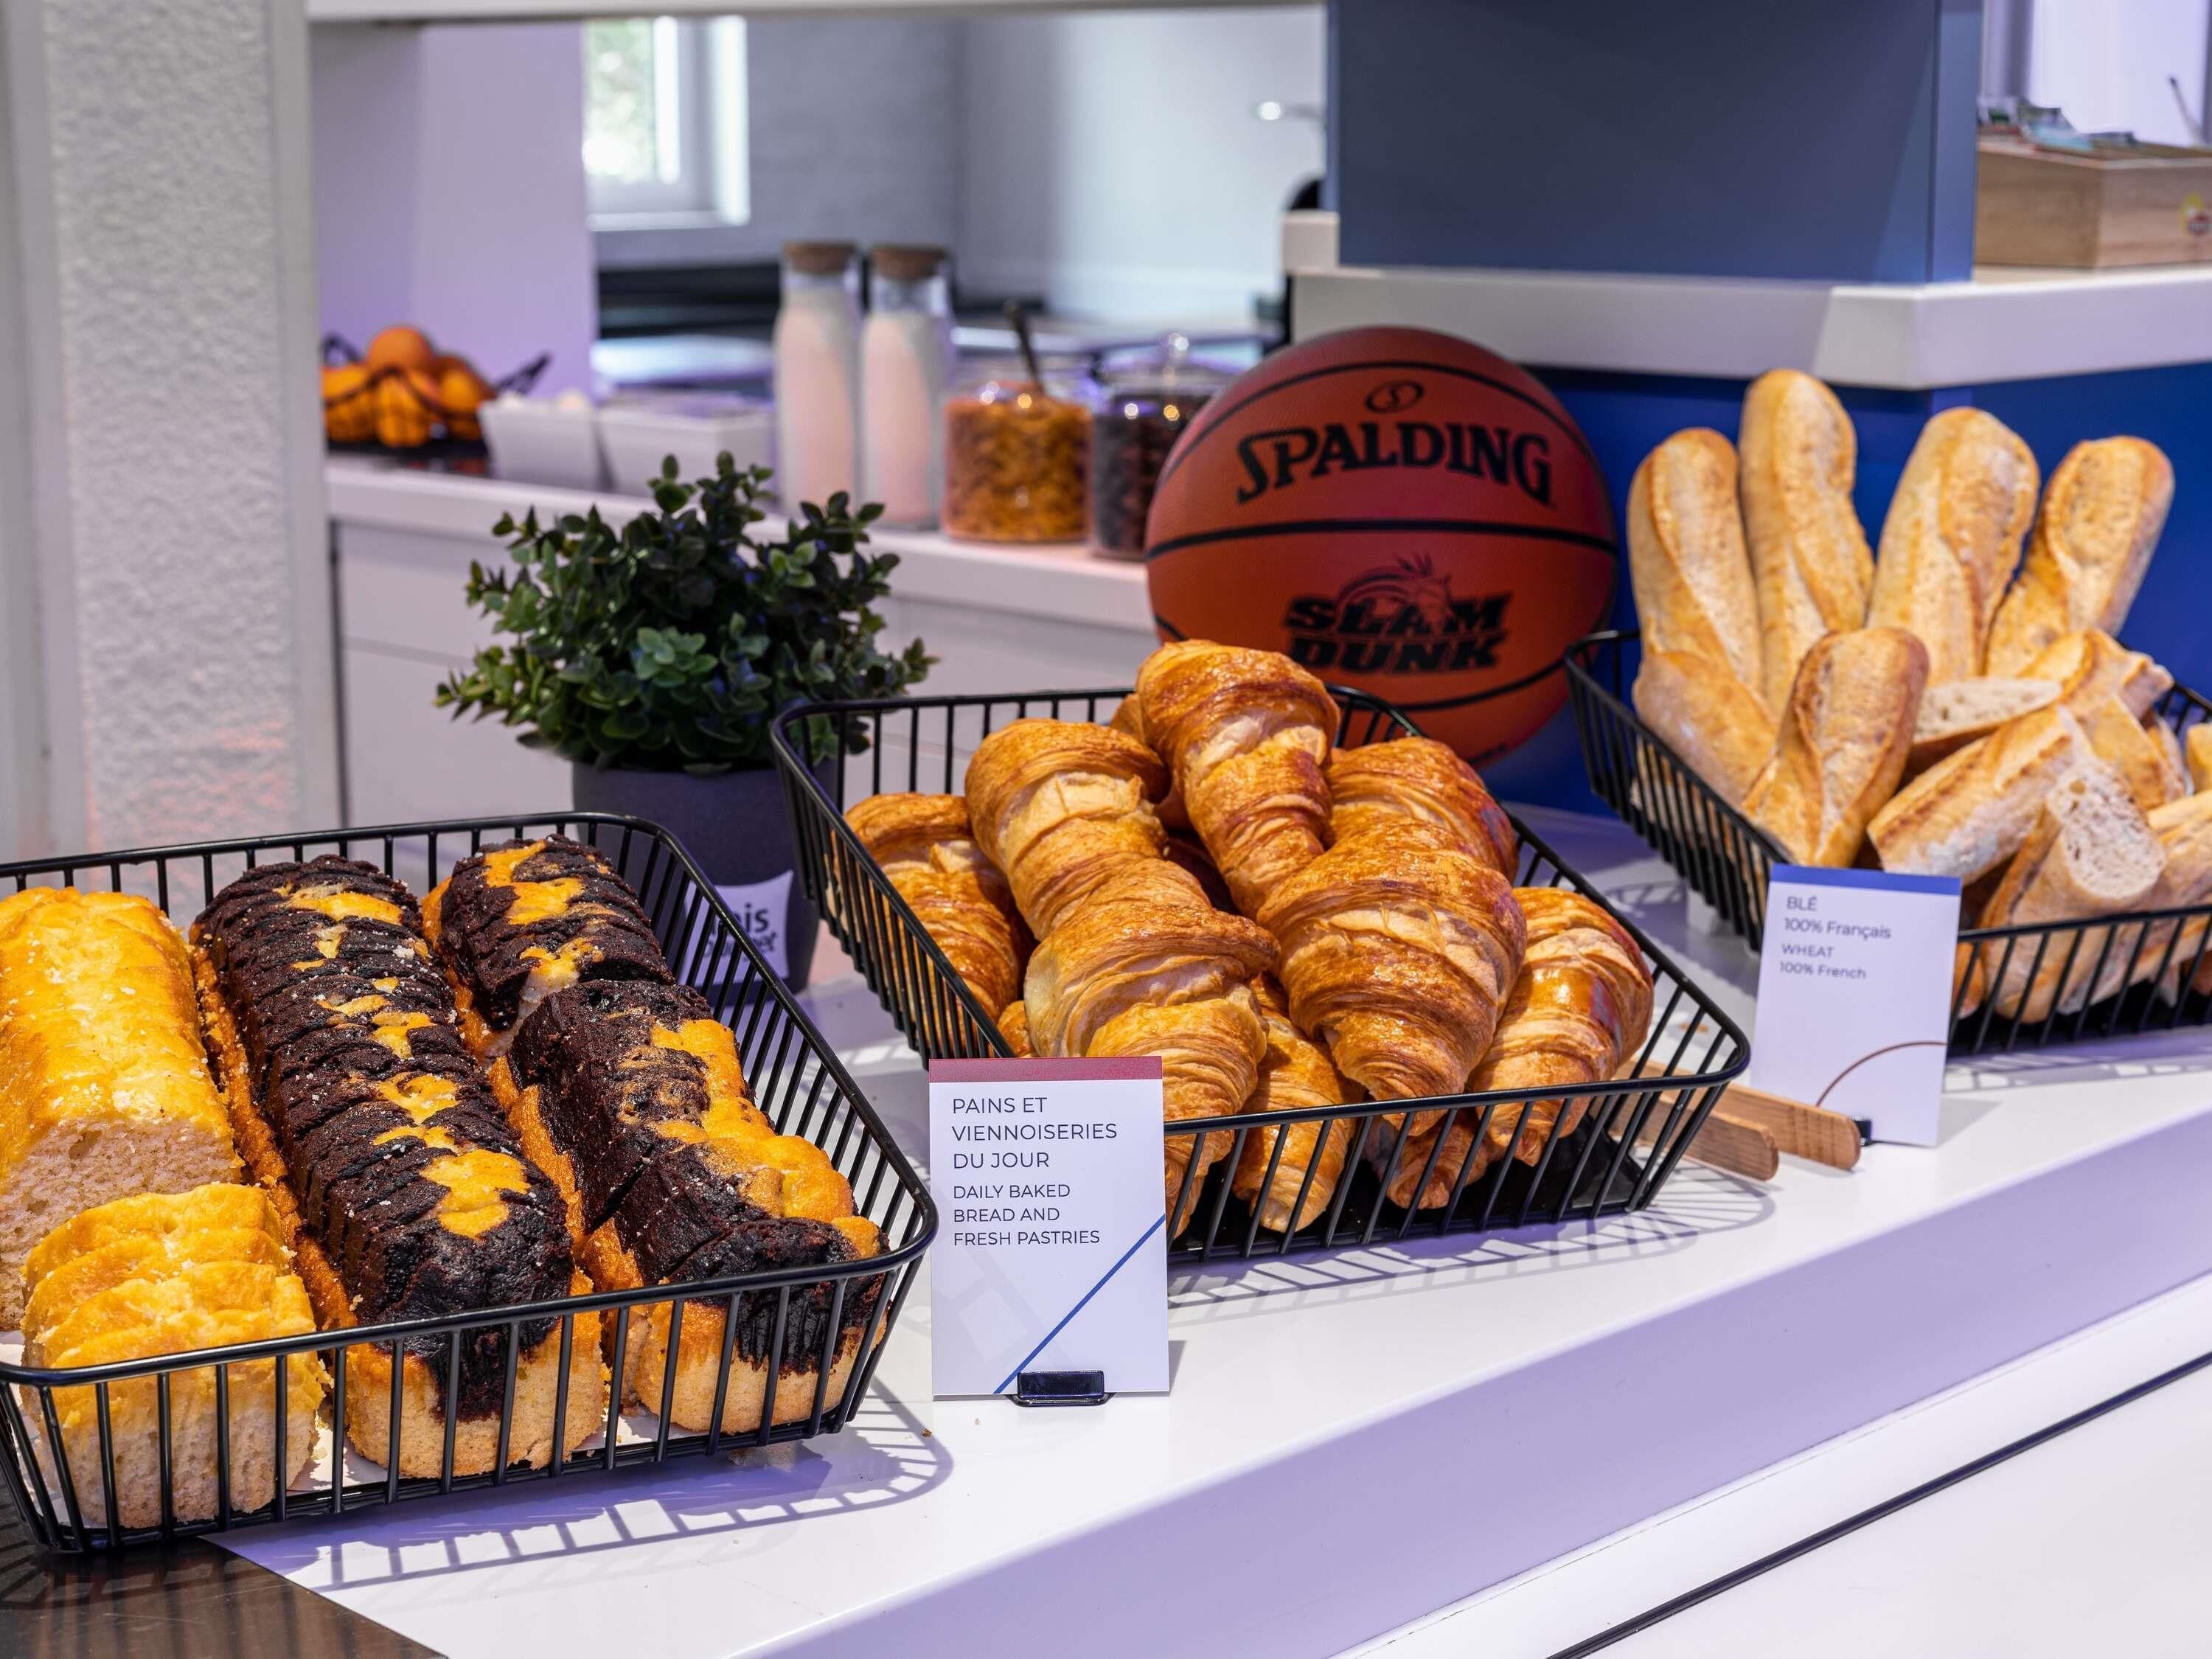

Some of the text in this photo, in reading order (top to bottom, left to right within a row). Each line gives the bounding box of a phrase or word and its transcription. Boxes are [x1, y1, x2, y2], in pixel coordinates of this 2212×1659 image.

[1237, 422, 1552, 506] SPALDING
[1286, 591, 1512, 632] SLAM
[1291, 633, 1505, 672] DUNK
[1787, 896, 1818, 911] BLÉ
[1784, 918, 1891, 940] 100% Français
[1781, 943, 1834, 959] WHEAT
[1779, 961, 1866, 979] 100% French
[953, 1096, 1048, 1114] PAINS ET
[951, 1123, 1118, 1142] VIENNOISERIES
[953, 1152, 1050, 1169] DU JOUR
[953, 1183, 1071, 1200] DAILY BAKED
[953, 1207, 1060, 1222] BREAD AND
[954, 1229, 1101, 1246] FRESH PASTRIES
